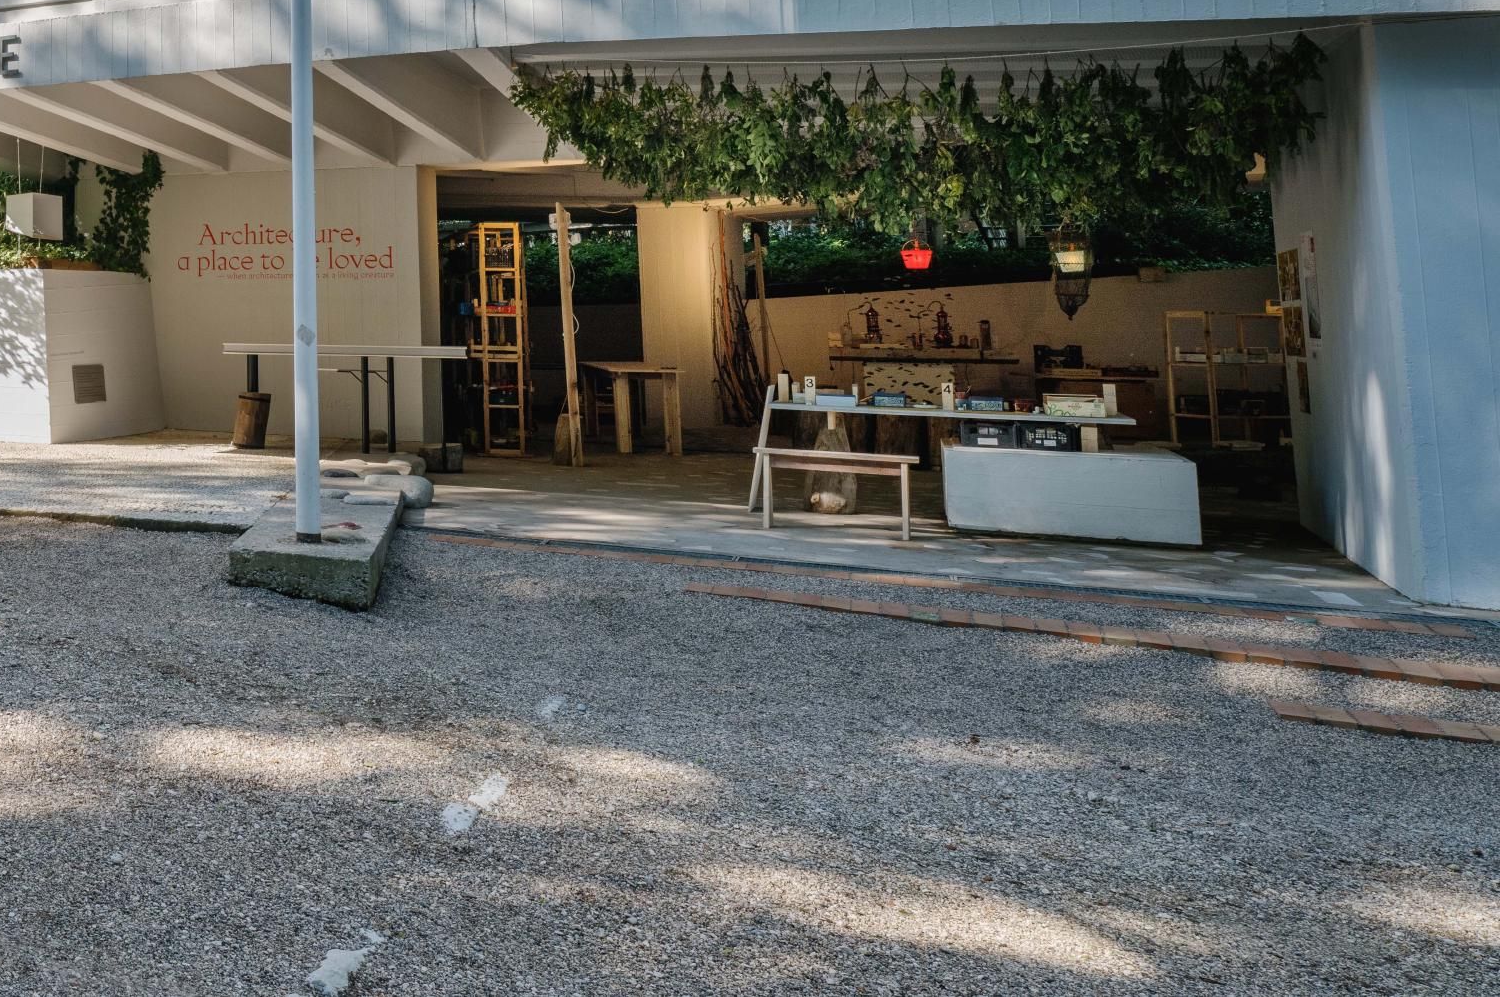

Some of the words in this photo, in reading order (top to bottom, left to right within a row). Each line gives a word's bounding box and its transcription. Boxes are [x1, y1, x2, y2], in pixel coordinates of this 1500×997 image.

[198, 223, 361, 247] Architeure,
[177, 255, 190, 271] a
[197, 249, 254, 276] place
[260, 253, 285, 271] to
[328, 246, 395, 269] loved
[227, 271, 246, 280] when
[360, 271, 395, 279] creature
[806, 378, 814, 388] 3
[943, 384, 951, 394] 4
